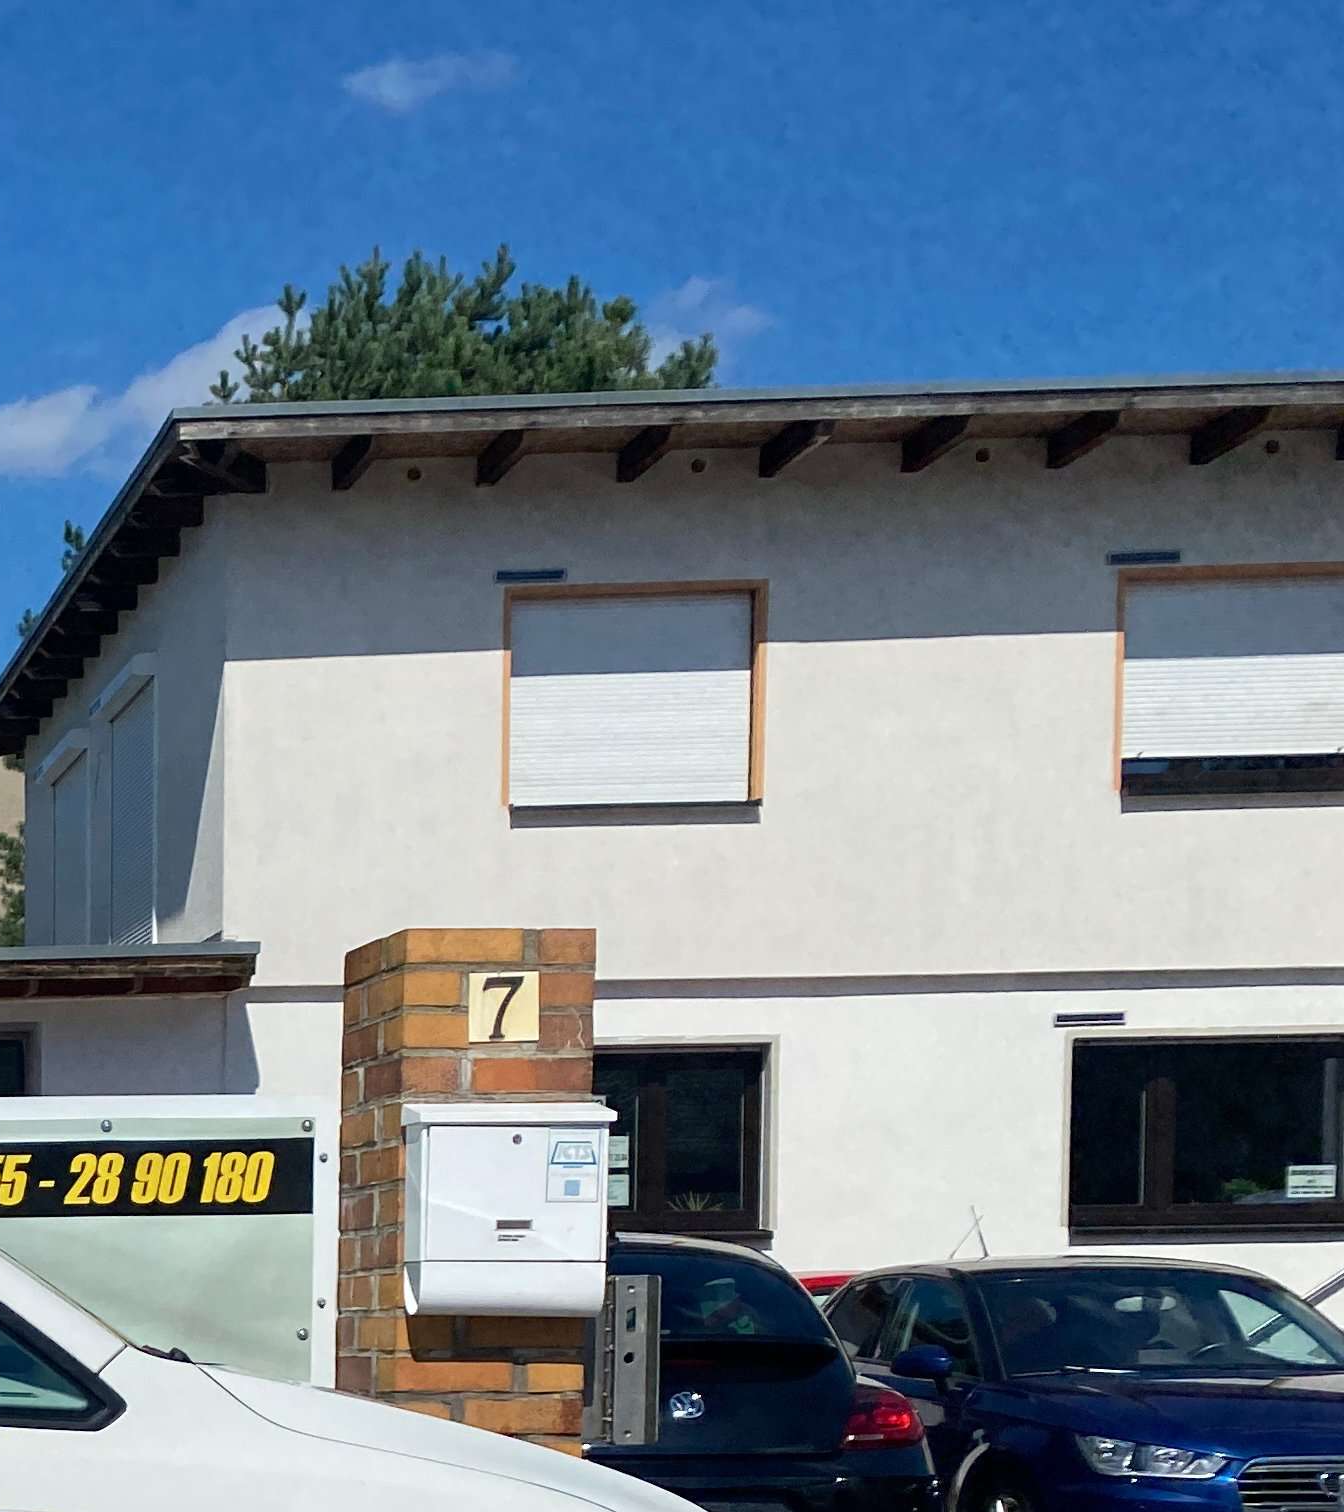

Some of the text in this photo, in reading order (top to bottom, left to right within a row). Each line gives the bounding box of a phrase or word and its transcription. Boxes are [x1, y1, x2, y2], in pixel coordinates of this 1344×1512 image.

[482, 976, 525, 1040] 7
[64, 1153, 125, 1205] 28
[130, 1152, 192, 1204] 90
[200, 1151, 275, 1203] 180
